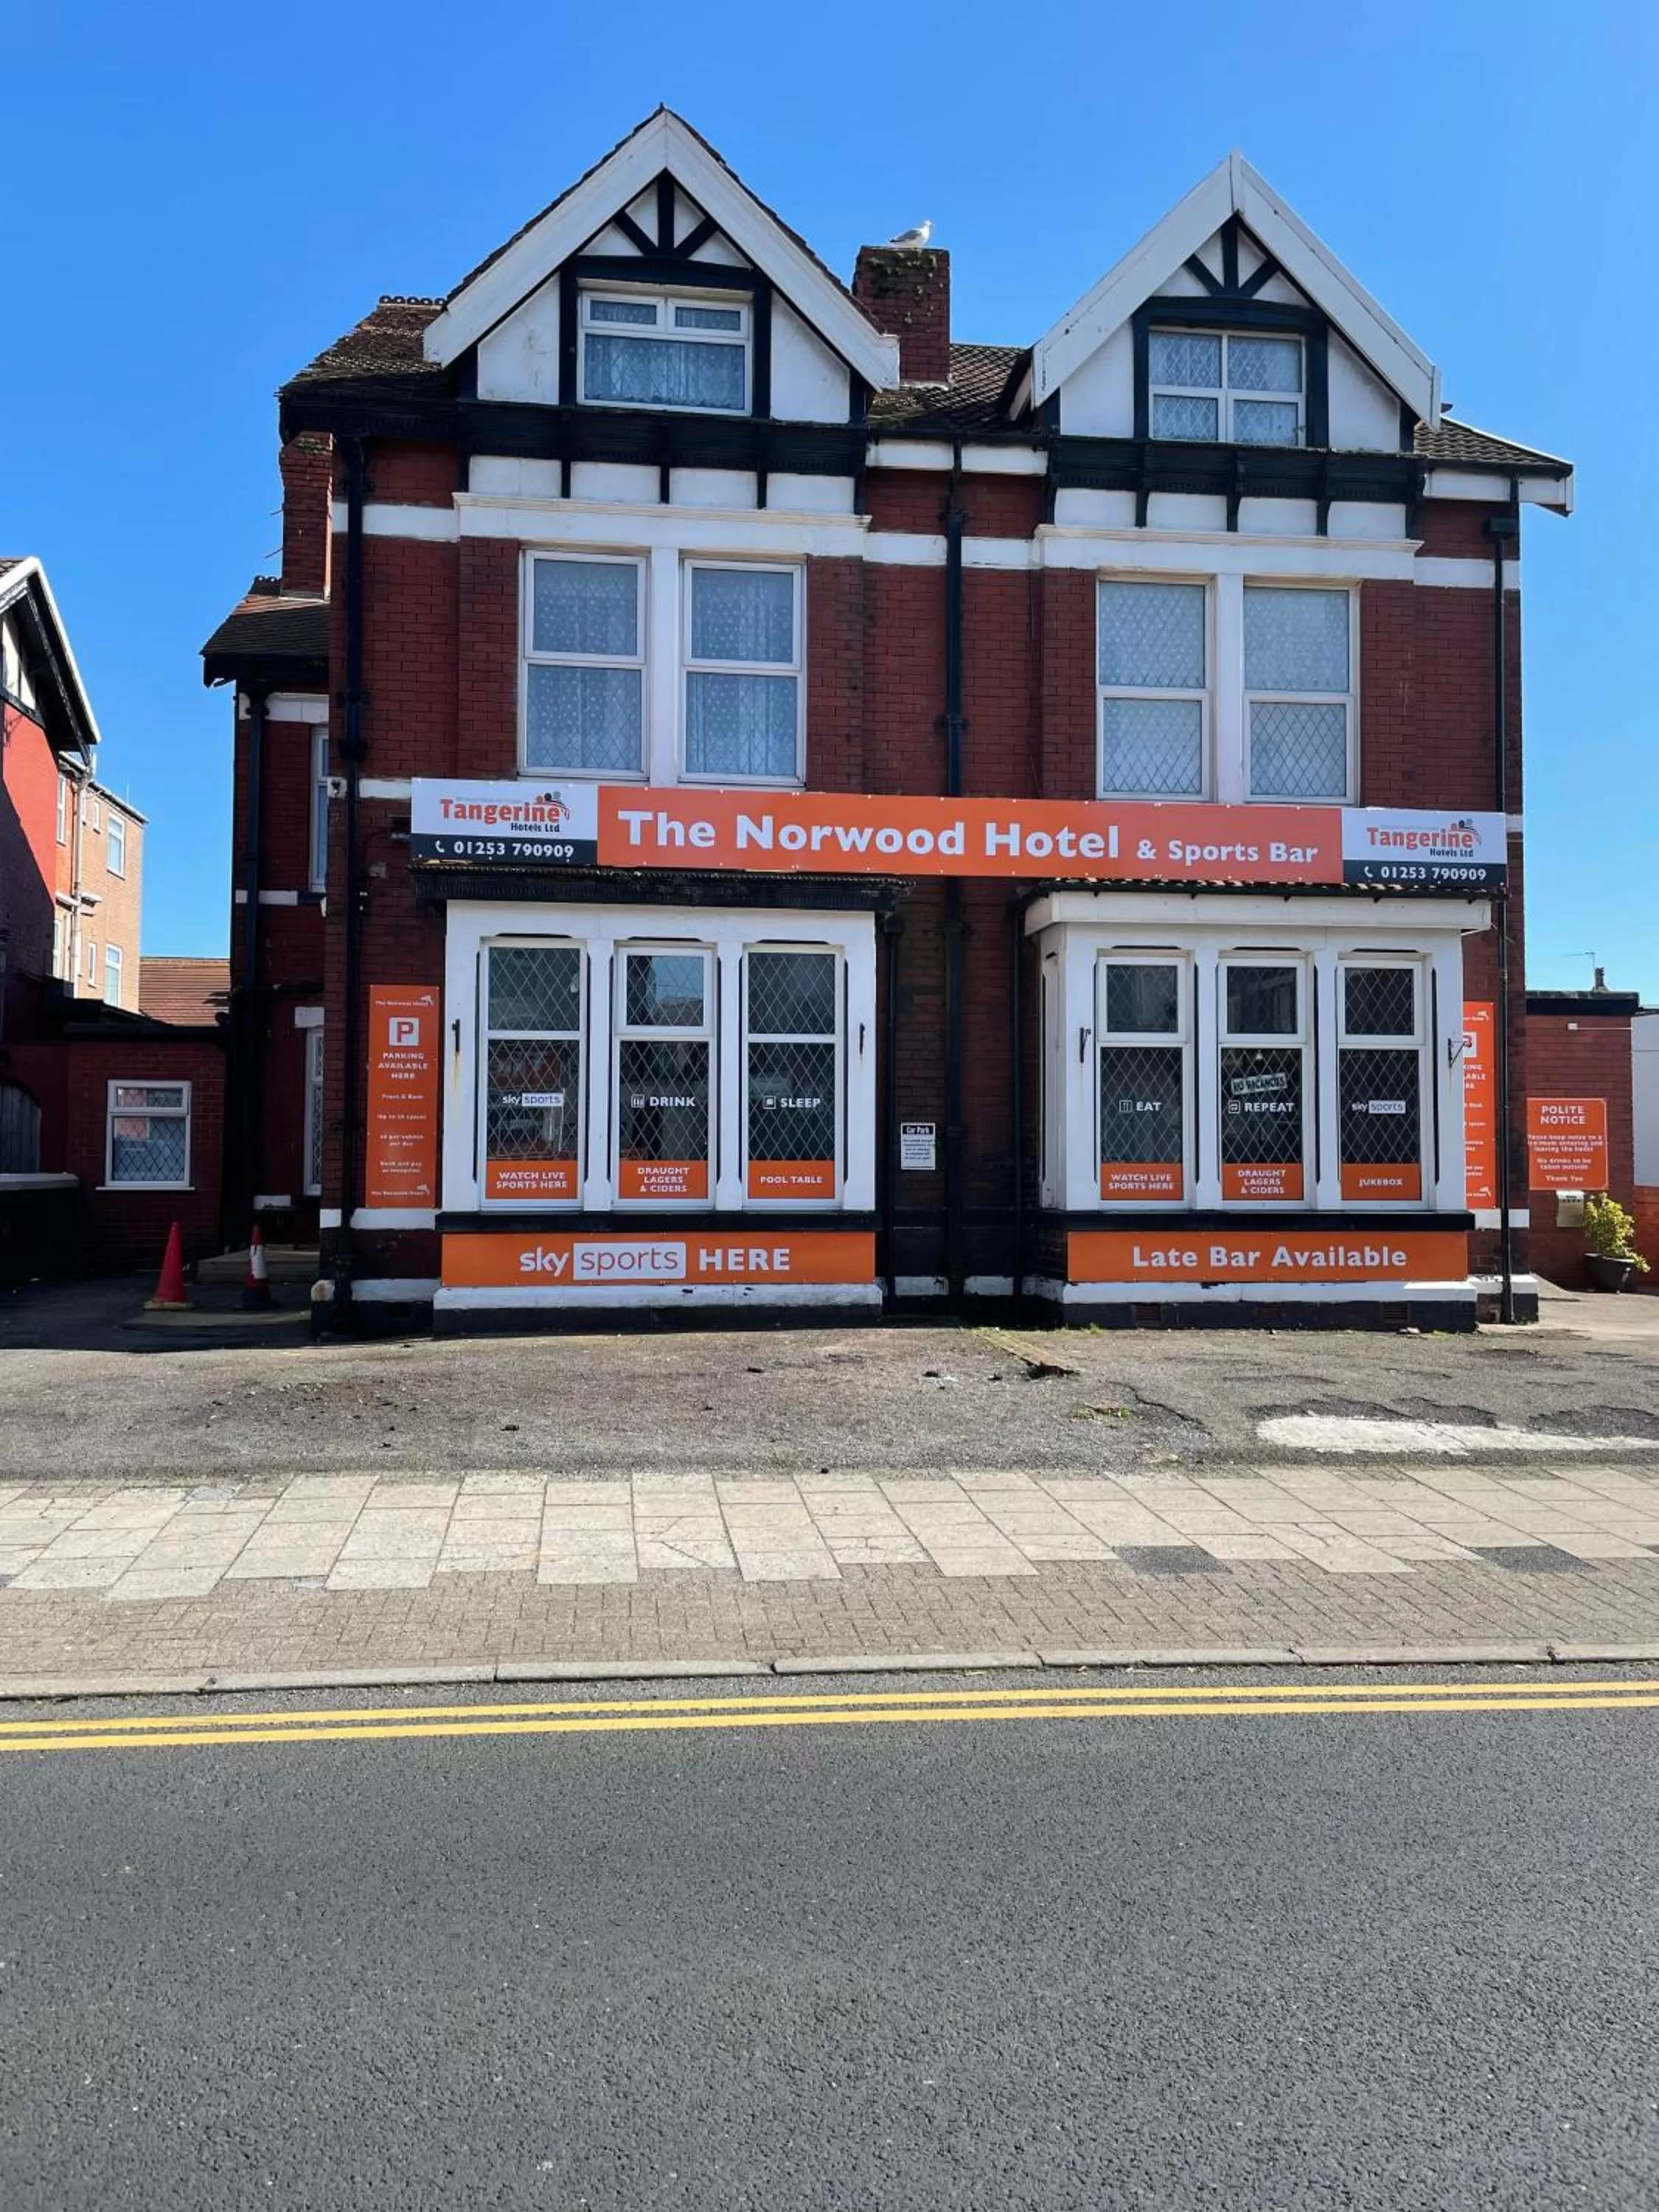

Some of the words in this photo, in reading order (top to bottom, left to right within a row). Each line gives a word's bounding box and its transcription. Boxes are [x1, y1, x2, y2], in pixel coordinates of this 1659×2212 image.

[439, 799, 561, 825] Tangerine
[510, 823, 542, 832] Hotels
[545, 823, 560, 832] Ltd
[618, 810, 716, 847] The
[737, 813, 965, 855] Norwood
[984, 822, 1119, 858] Hotel
[1136, 840, 1157, 859] &
[1168, 840, 1259, 866] Sports
[1270, 843, 1318, 863] Bar
[1366, 827, 1473, 849] Tangerine
[453, 841, 506, 855] 01253
[512, 843, 574, 858] 790909
[1430, 848, 1458, 857] Hotels
[1459, 849, 1474, 858] Ltd
[1381, 866, 1426, 878] 01253
[1431, 868, 1486, 880] 790909
[397, 1021, 414, 1043] P
[503, 1093, 521, 1105] sky
[524, 1095, 561, 1105] sports
[650, 1096, 696, 1107] DRINK
[780, 1098, 821, 1108] SLEEP
[1136, 1102, 1161, 1111] EAT
[1244, 1102, 1295, 1112] REPEAT
[1352, 1101, 1368, 1112] sky
[1371, 1102, 1403, 1112] sports
[1542, 1105, 1586, 1114] POLITE
[1540, 1116, 1587, 1124] NOTICE
[498, 1172, 540, 1180] WATCH
[1110, 1173, 1148, 1181] WATCH
[1150, 1173, 1173, 1181] LIVE
[1238, 1169, 1287, 1178] DRAUGHT
[495, 1180, 538, 1189] SPORTS
[540, 1180, 568, 1189] HERE
[1244, 1178, 1281, 1186] LAGERS
[1359, 1178, 1403, 1187] JUKEBOX
[1240, 1186, 1248, 1194] &
[1248, 1186, 1285, 1194] CIDERS
[1133, 1245, 1198, 1267] Late
[1209, 1246, 1261, 1267] Bar
[1270, 1245, 1408, 1267] Available
[519, 1247, 570, 1276] sky
[580, 1248, 678, 1276] sports
[699, 1248, 791, 1270] HERE
